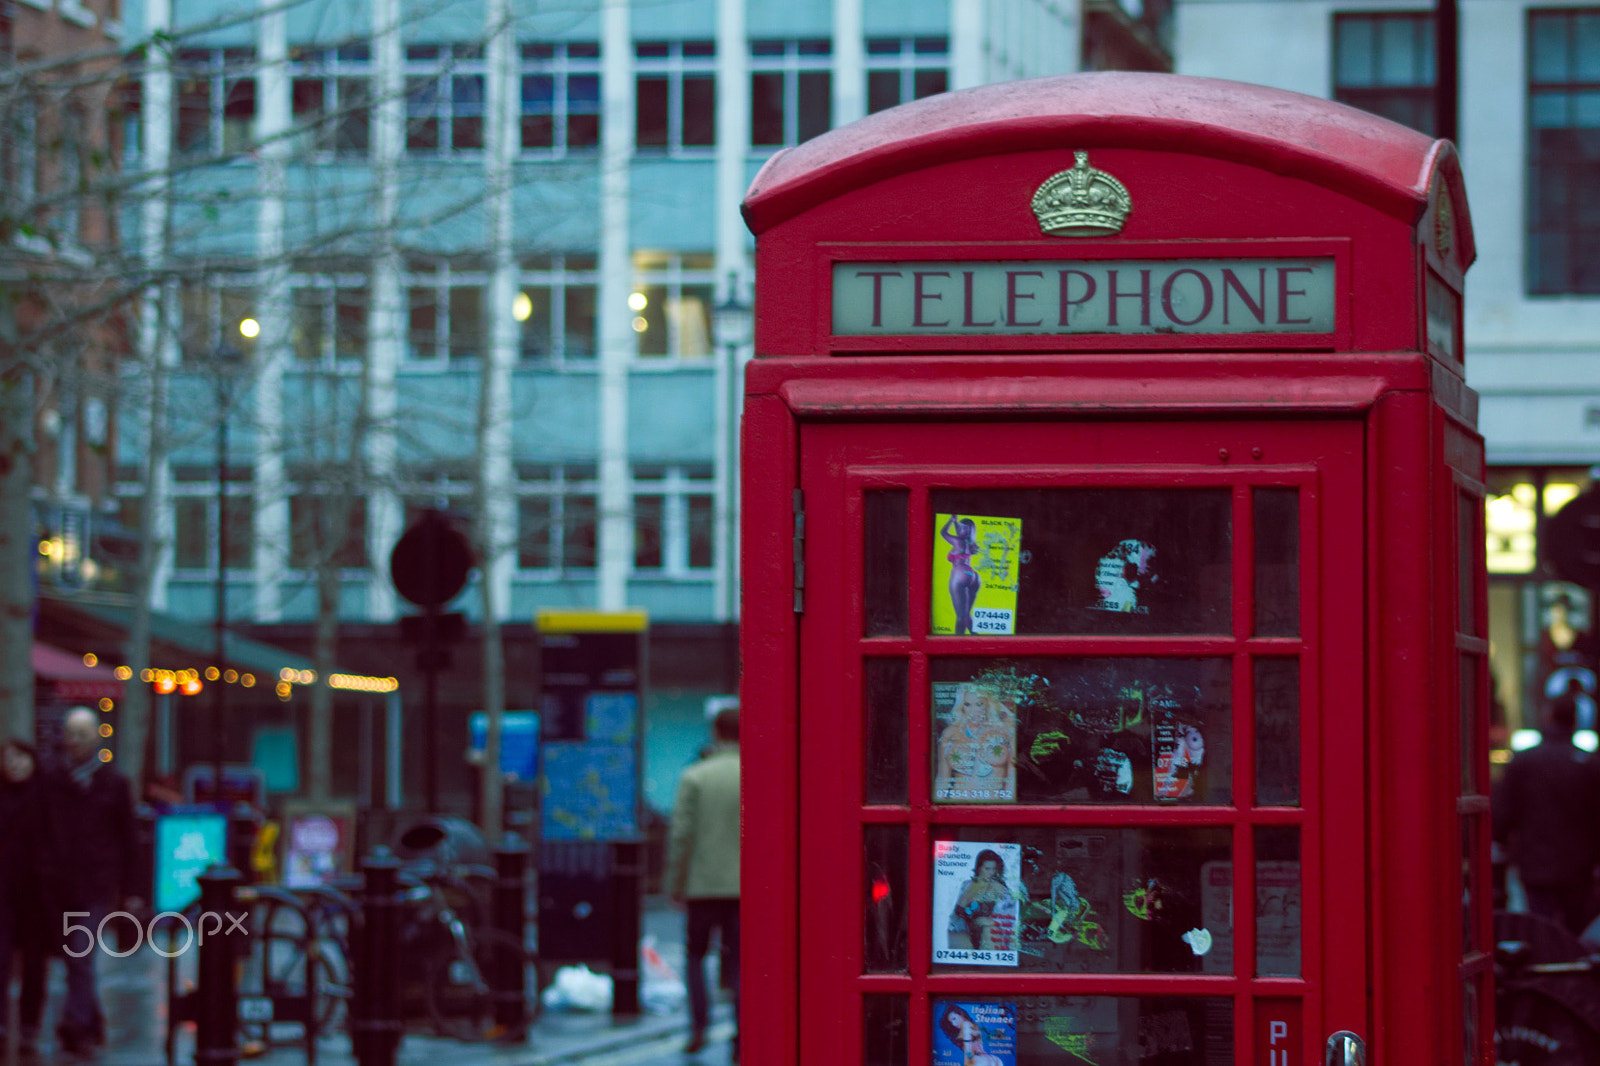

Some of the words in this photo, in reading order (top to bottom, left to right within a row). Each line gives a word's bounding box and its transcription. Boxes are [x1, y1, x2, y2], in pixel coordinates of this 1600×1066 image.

[855, 267, 1314, 328] TELEPHONE
[974, 611, 1010, 619] 074449
[977, 622, 1006, 630] 45126
[936, 790, 969, 799] 07554
[971, 790, 990, 799] 318
[993, 790, 1012, 799] 752
[938, 844, 959, 852] Busty
[936, 951, 968, 959] 07444
[971, 951, 991, 960] 945
[995, 953, 1014, 961] 126
[971, 1006, 1005, 1014] Italian
[975, 1014, 1014, 1024] Stunner
